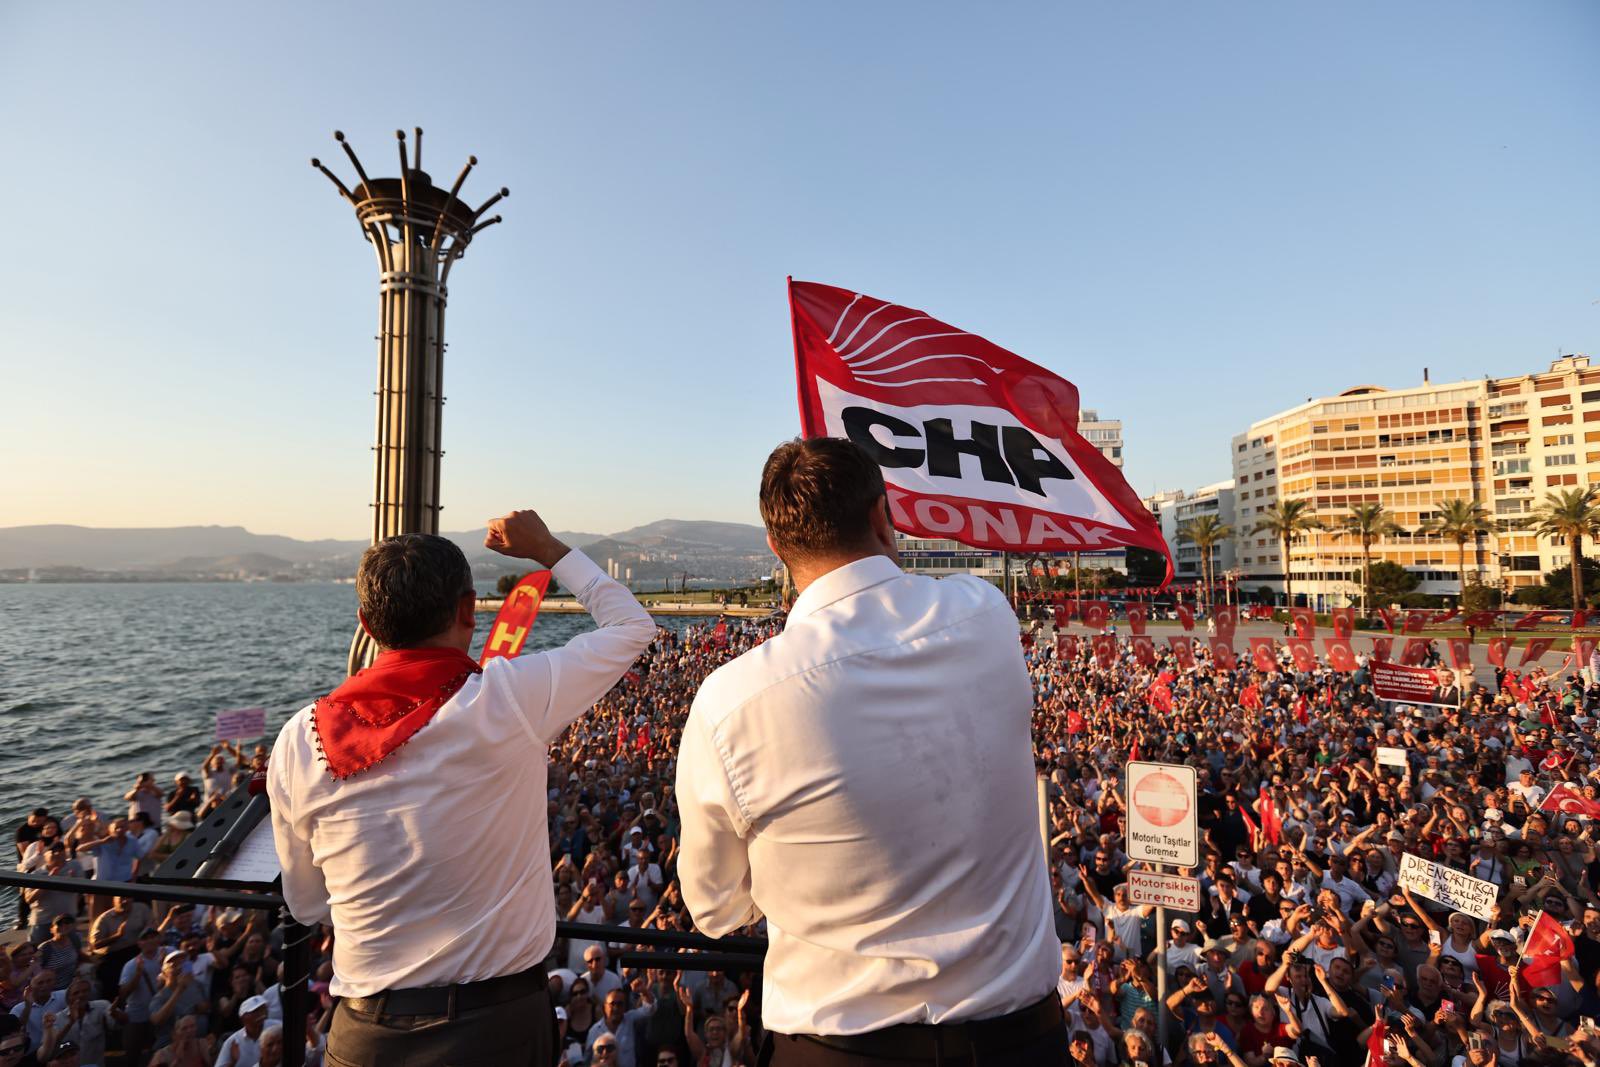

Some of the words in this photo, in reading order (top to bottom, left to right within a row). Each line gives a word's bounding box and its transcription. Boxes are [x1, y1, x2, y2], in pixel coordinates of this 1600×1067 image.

[841, 406, 1074, 497] CHP
[1132, 832, 1161, 844] Motorlu
[1163, 835, 1191, 847] Taşıtlar
[1145, 845, 1178, 858] Giremez
[1131, 876, 1195, 893] Motorsiklet
[1133, 889, 1194, 906] Giremez
[1434, 891, 1483, 917] AZALIR
